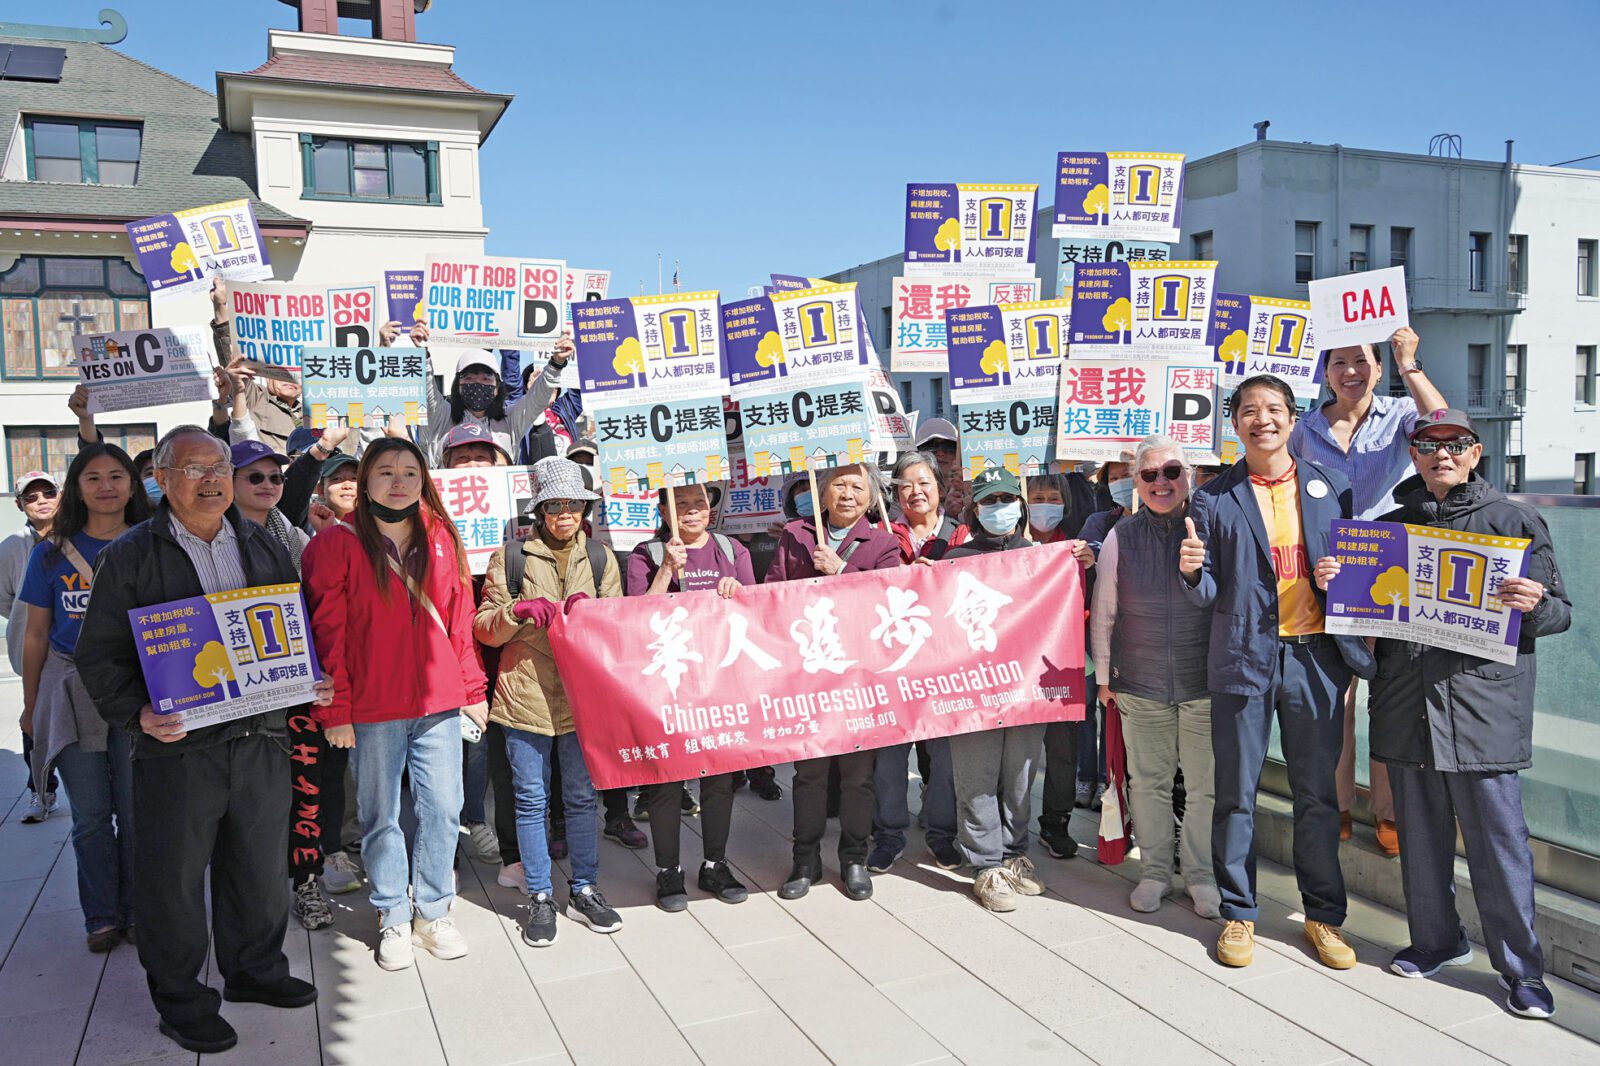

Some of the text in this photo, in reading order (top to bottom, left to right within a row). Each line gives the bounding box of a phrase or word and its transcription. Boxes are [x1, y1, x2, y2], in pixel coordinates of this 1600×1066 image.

[1114, 166, 1126, 190] 支持
[1136, 170, 1152, 201] I
[1162, 168, 1174, 192] 支持
[965, 198, 976, 224] 支持
[988, 203, 1003, 236] I
[1015, 199, 1026, 225] 支持
[1113, 211, 1169, 222] 人人都可安居
[188, 222, 204, 245] 支持
[210, 221, 232, 249] I
[234, 213, 250, 236] 支持
[205, 254, 257, 271] 人人都可安居
[965, 247, 1024, 257] 人人都可安居
[431, 263, 516, 287] DON'T ROB
[525, 269, 557, 284] NO
[587, 276, 606, 289] 反對
[334, 292, 370, 309] NO
[429, 286, 515, 310] OUR RIGHT
[524, 284, 557, 299] ON
[993, 285, 1032, 303] 反對
[1137, 277, 1150, 304] 支持
[1161, 281, 1180, 316] I
[1192, 277, 1206, 304] 支持
[1342, 285, 1395, 322] CAA
[233, 291, 324, 317] DON'T ROB
[334, 308, 370, 325] ON
[523, 300, 557, 334] D
[836, 299, 850, 327] 支持
[236, 316, 324, 342] OUR RIGHT
[427, 309, 499, 332] TO VOTE.
[643, 313, 658, 343] 支持
[699, 308, 713, 338] 支持
[783, 308, 797, 335] 支持
[807, 307, 827, 343] I
[1010, 318, 1023, 345] 支持
[1136, 328, 1201, 339] 人人都可安居
[1254, 312, 1269, 339] 支持
[164, 334, 201, 347] HOMES
[669, 315, 690, 353] I
[1034, 320, 1052, 355] I
[1276, 319, 1297, 353] I
[135, 333, 163, 373] C
[167, 348, 186, 358] FOR
[238, 341, 258, 363] TO
[538, 351, 554, 359] YE
[791, 350, 853, 368] 人人都可安居
[82, 360, 135, 380] YES ON
[304, 349, 423, 385] 支持C提案
[652, 362, 715, 379] 人人都可安居
[1171, 368, 1214, 389] 反對
[1250, 360, 1310, 377] 人人都可安居
[1066, 367, 1146, 405] 還我
[744, 391, 863, 428] 支持C提案
[872, 391, 896, 414] D
[1172, 393, 1212, 421] D
[598, 404, 722, 442] 支持C提案
[878, 416, 906, 433] 提案
[1168, 423, 1211, 444] 提案
[985, 470, 1002, 482] M
[724, 488, 782, 514] 票權！
[454, 517, 509, 547] 權！
[1337, 527, 1396, 540] 不增加稅收。
[1336, 542, 1384, 553] 興建房屋。
[684, 569, 719, 577] nxious
[1336, 555, 1383, 567] 幫助租客。
[1416, 545, 1435, 579] 支持
[1448, 556, 1473, 601] I
[64, 594, 89, 608] NO
[138, 607, 201, 625] 不增加稅收。
[225, 610, 248, 645] 支持
[283, 602, 300, 635] 支持
[1416, 606, 1500, 635] 人人都可安居
[142, 624, 194, 641] 興建房屋。
[255, 610, 282, 655] I
[641, 571, 1013, 700] 華人進步會
[146, 638, 197, 656] 幫助租客。
[244, 663, 308, 688] 人人都可安居
[661, 659, 1024, 735] Chinese Progressive Association
[932, 684, 1073, 716] Educate. Organize. Empower.
[846, 711, 897, 734] cpasf.org
[619, 742, 670, 763] 宣傳教育
[763, 719, 820, 739] 增加力量
[288, 716, 322, 866] CHANGE
